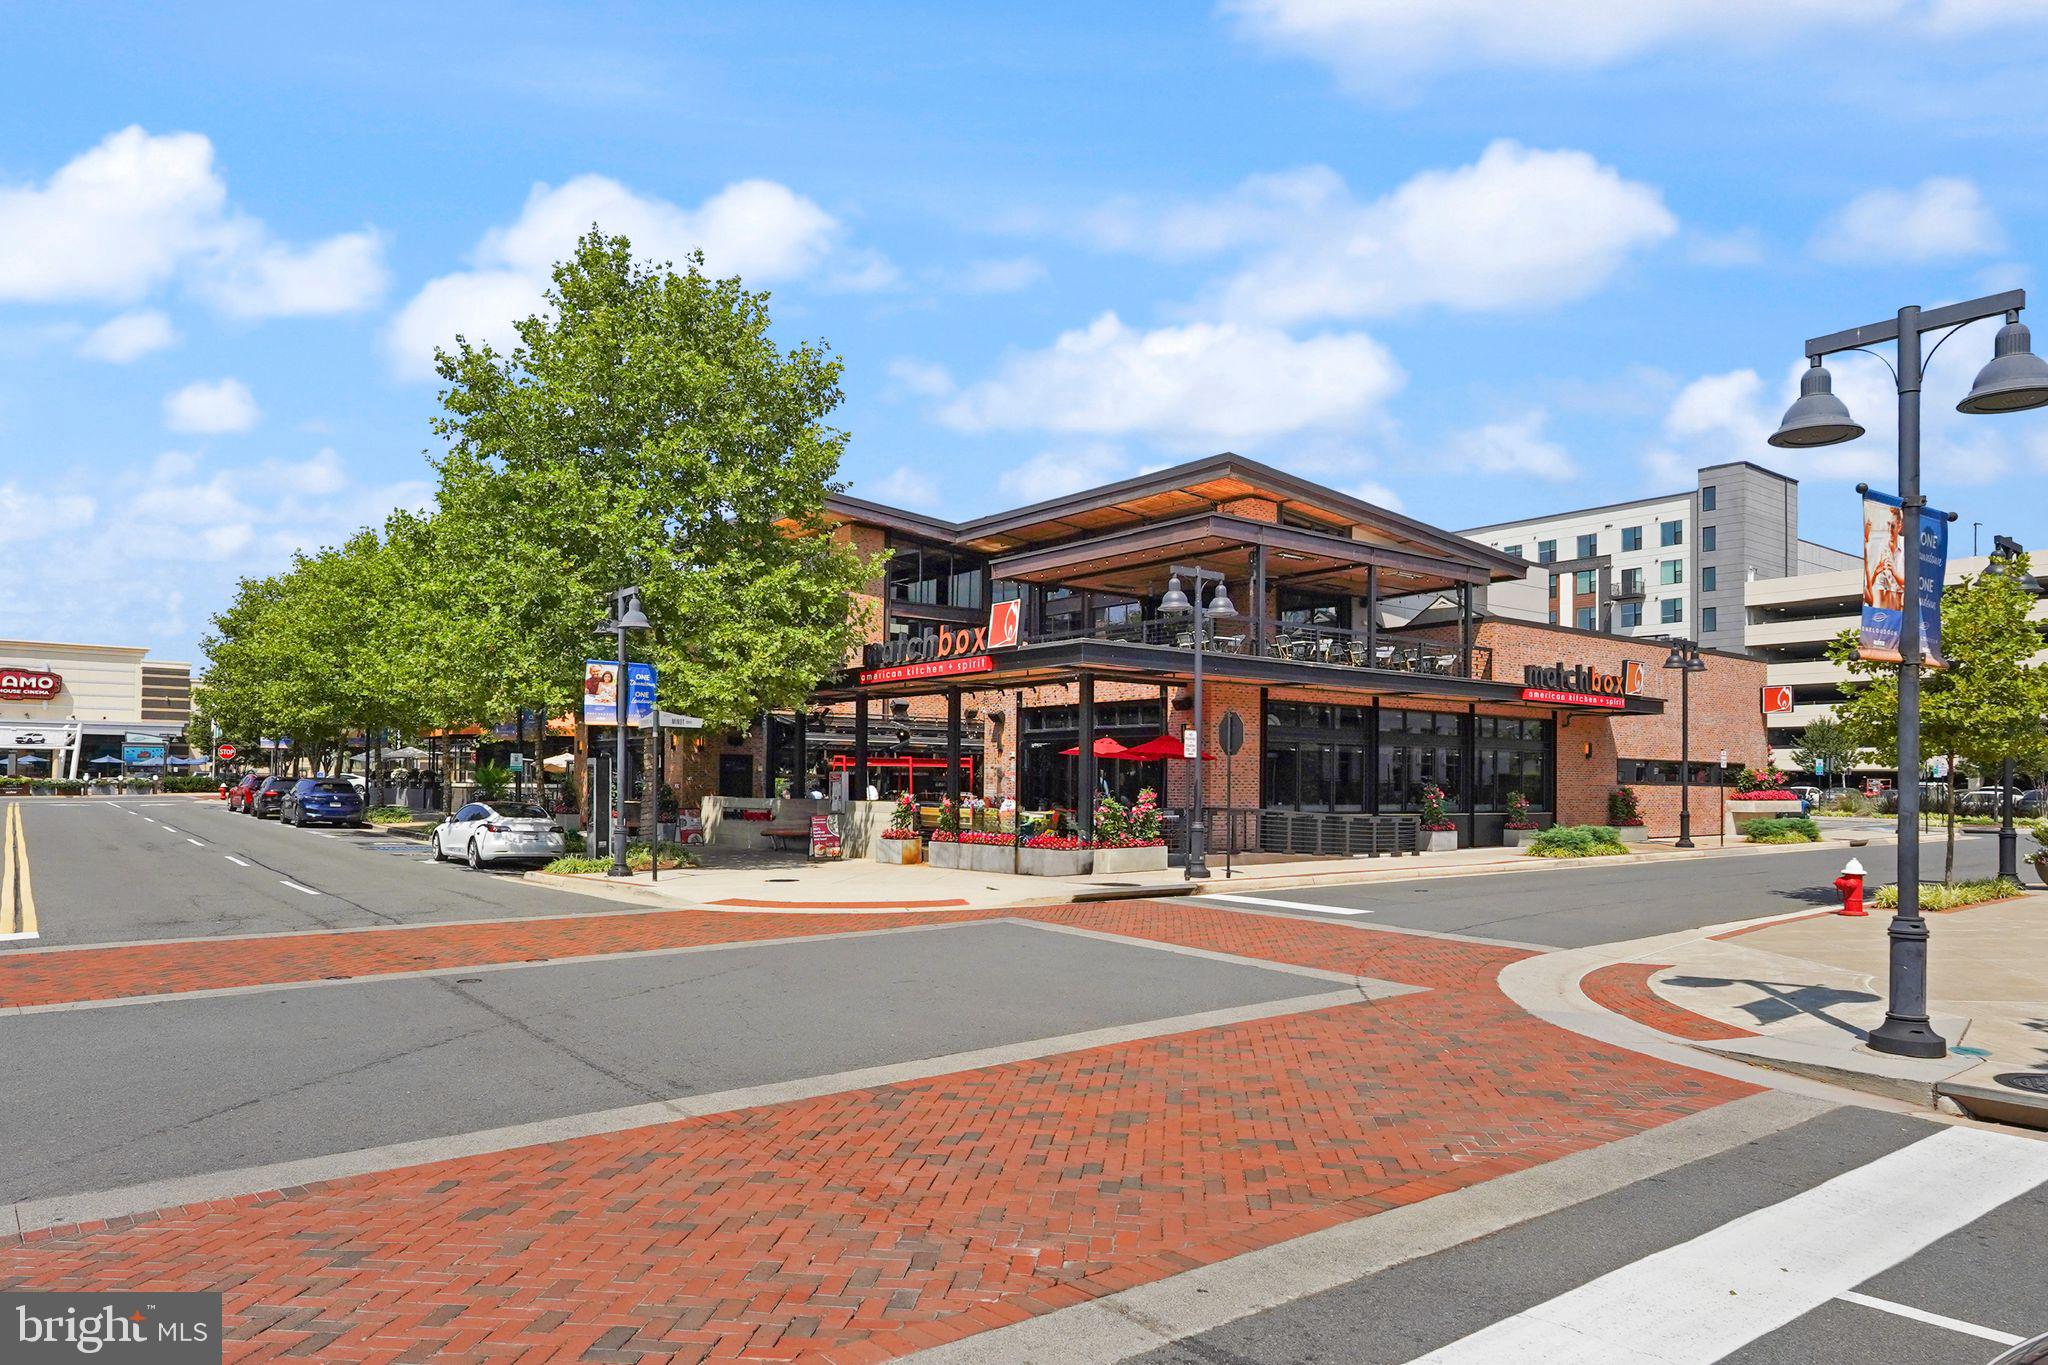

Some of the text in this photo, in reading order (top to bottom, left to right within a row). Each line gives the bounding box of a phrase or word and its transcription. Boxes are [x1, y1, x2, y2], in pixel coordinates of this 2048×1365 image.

[1920, 532, 1938, 549] ONE
[1919, 576, 1934, 593] ONE
[864, 624, 987, 668] matchbox
[635, 673, 650, 681] ONE
[860, 670, 902, 681] american
[906, 663, 944, 676] kitchen
[957, 658, 986, 672] spirit
[1525, 662, 1625, 695] matchbox
[1529, 691, 1565, 700] american
[1569, 693, 1598, 704] kitchen
[1606, 697, 1625, 707] spirit
